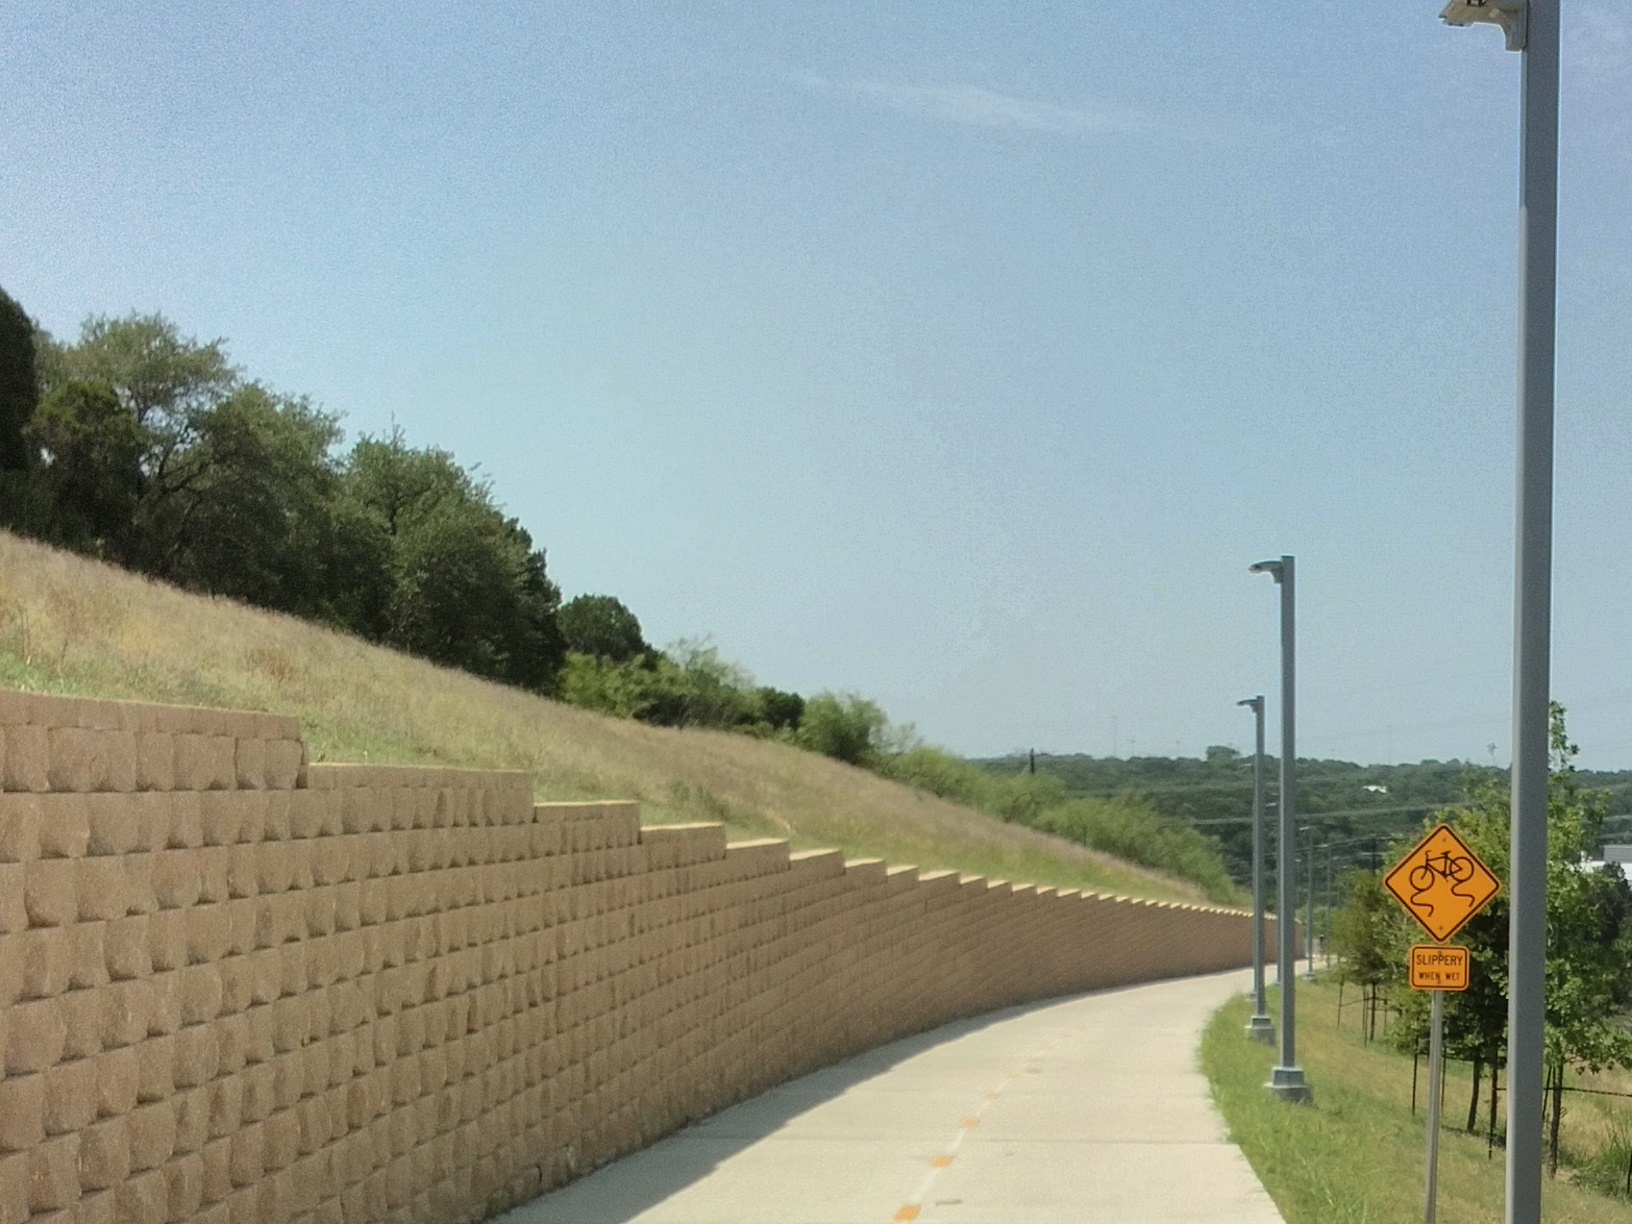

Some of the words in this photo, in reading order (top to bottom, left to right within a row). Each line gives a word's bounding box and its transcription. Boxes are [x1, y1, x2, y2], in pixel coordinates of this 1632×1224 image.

[1416, 955, 1463, 966] SLIPPERY
[1418, 972, 1441, 980] WHEN
[1445, 973, 1461, 981] WET
